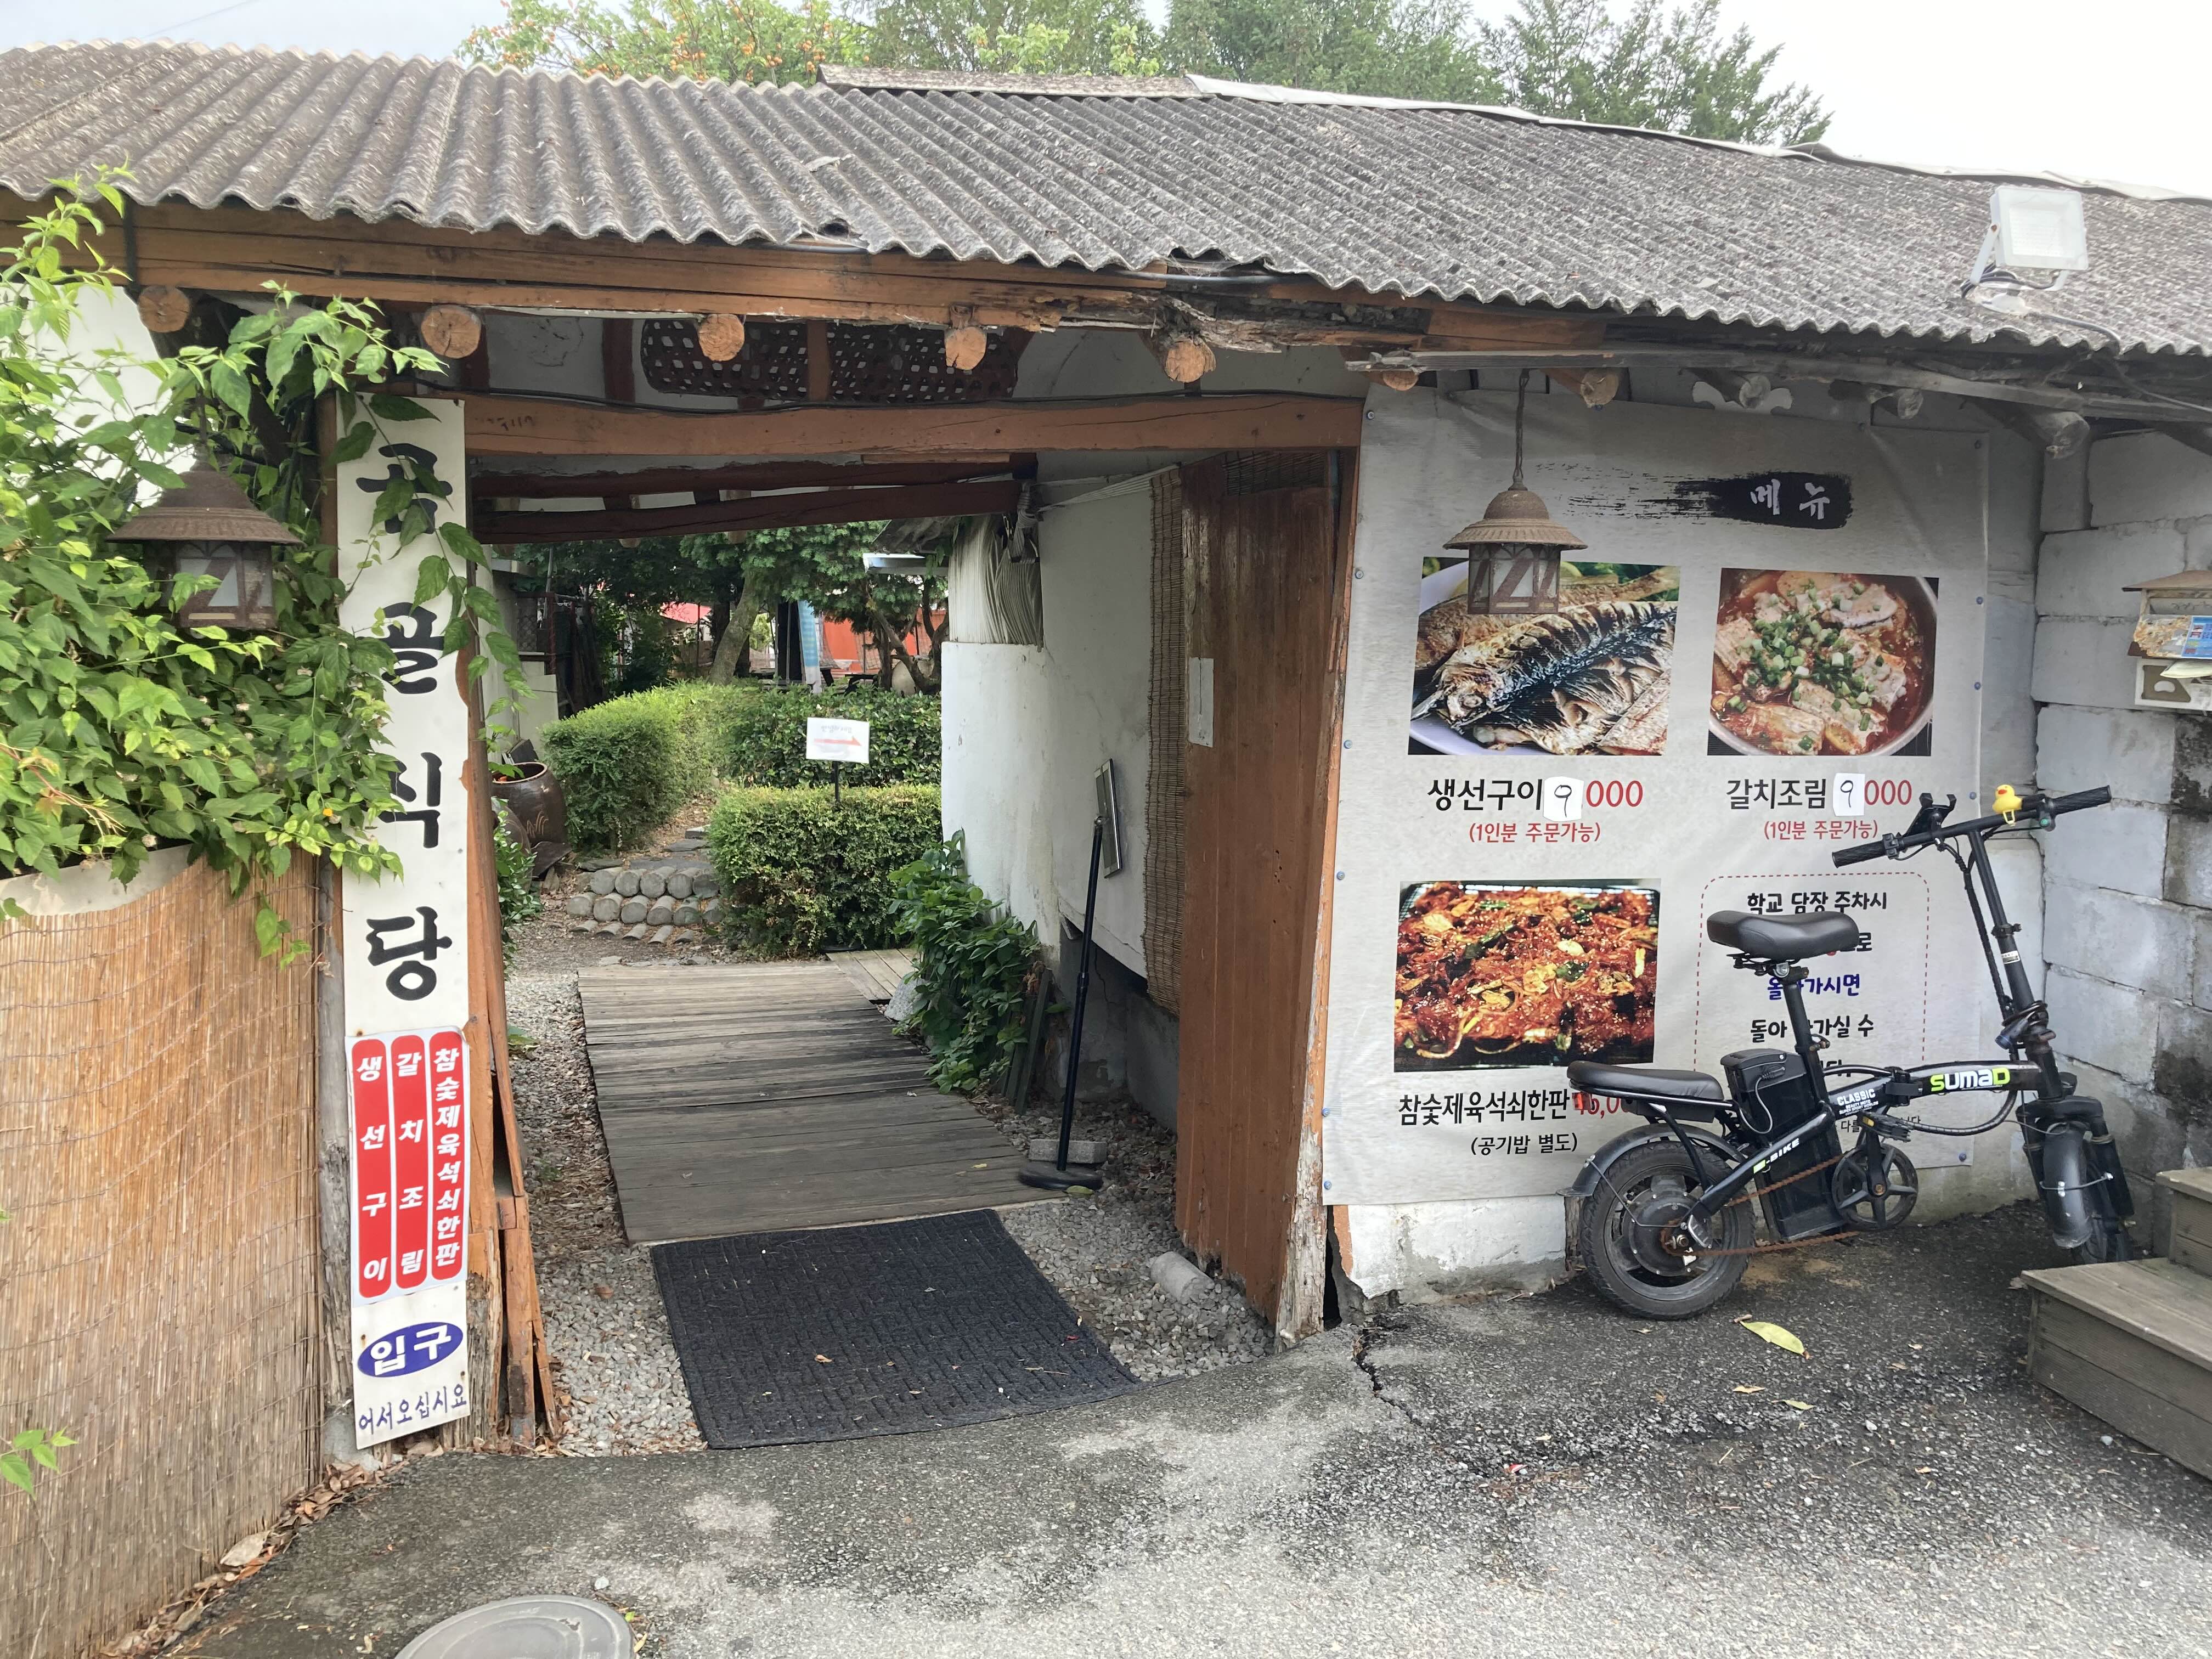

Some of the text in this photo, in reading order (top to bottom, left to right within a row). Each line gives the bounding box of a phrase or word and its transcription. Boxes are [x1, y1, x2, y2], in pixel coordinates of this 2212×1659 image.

[1427, 778, 1543, 811] 생선구이
[1726, 778, 1826, 810] 갈치조림
[1469, 822, 1601, 843] (1인분 주문가능)
[1764, 819, 1878, 840] (1인분 주문가능)
[1747, 893, 1783, 914] 학교
[1834, 891, 1887, 913] 주차시
[1767, 973, 1860, 1001] 올가시면
[1750, 1019, 1787, 1043] 돌아
[1858, 1014, 1875, 1037] 수
[1398, 1088, 1570, 1126] 참숯제육석쇠한판
[1837, 1088, 1876, 1106] CLASSIC
[432, 1047, 461, 1267] 참숯제육석쇠한판
[1471, 1132, 1578, 1156] (공기밥 별도)
[357, 1056, 387, 1283] 생선구이
[395, 1051, 425, 1274] 갈치조림
[370, 1324, 452, 1376] 입구
[358, 1383, 467, 1435] 어서오십시요
